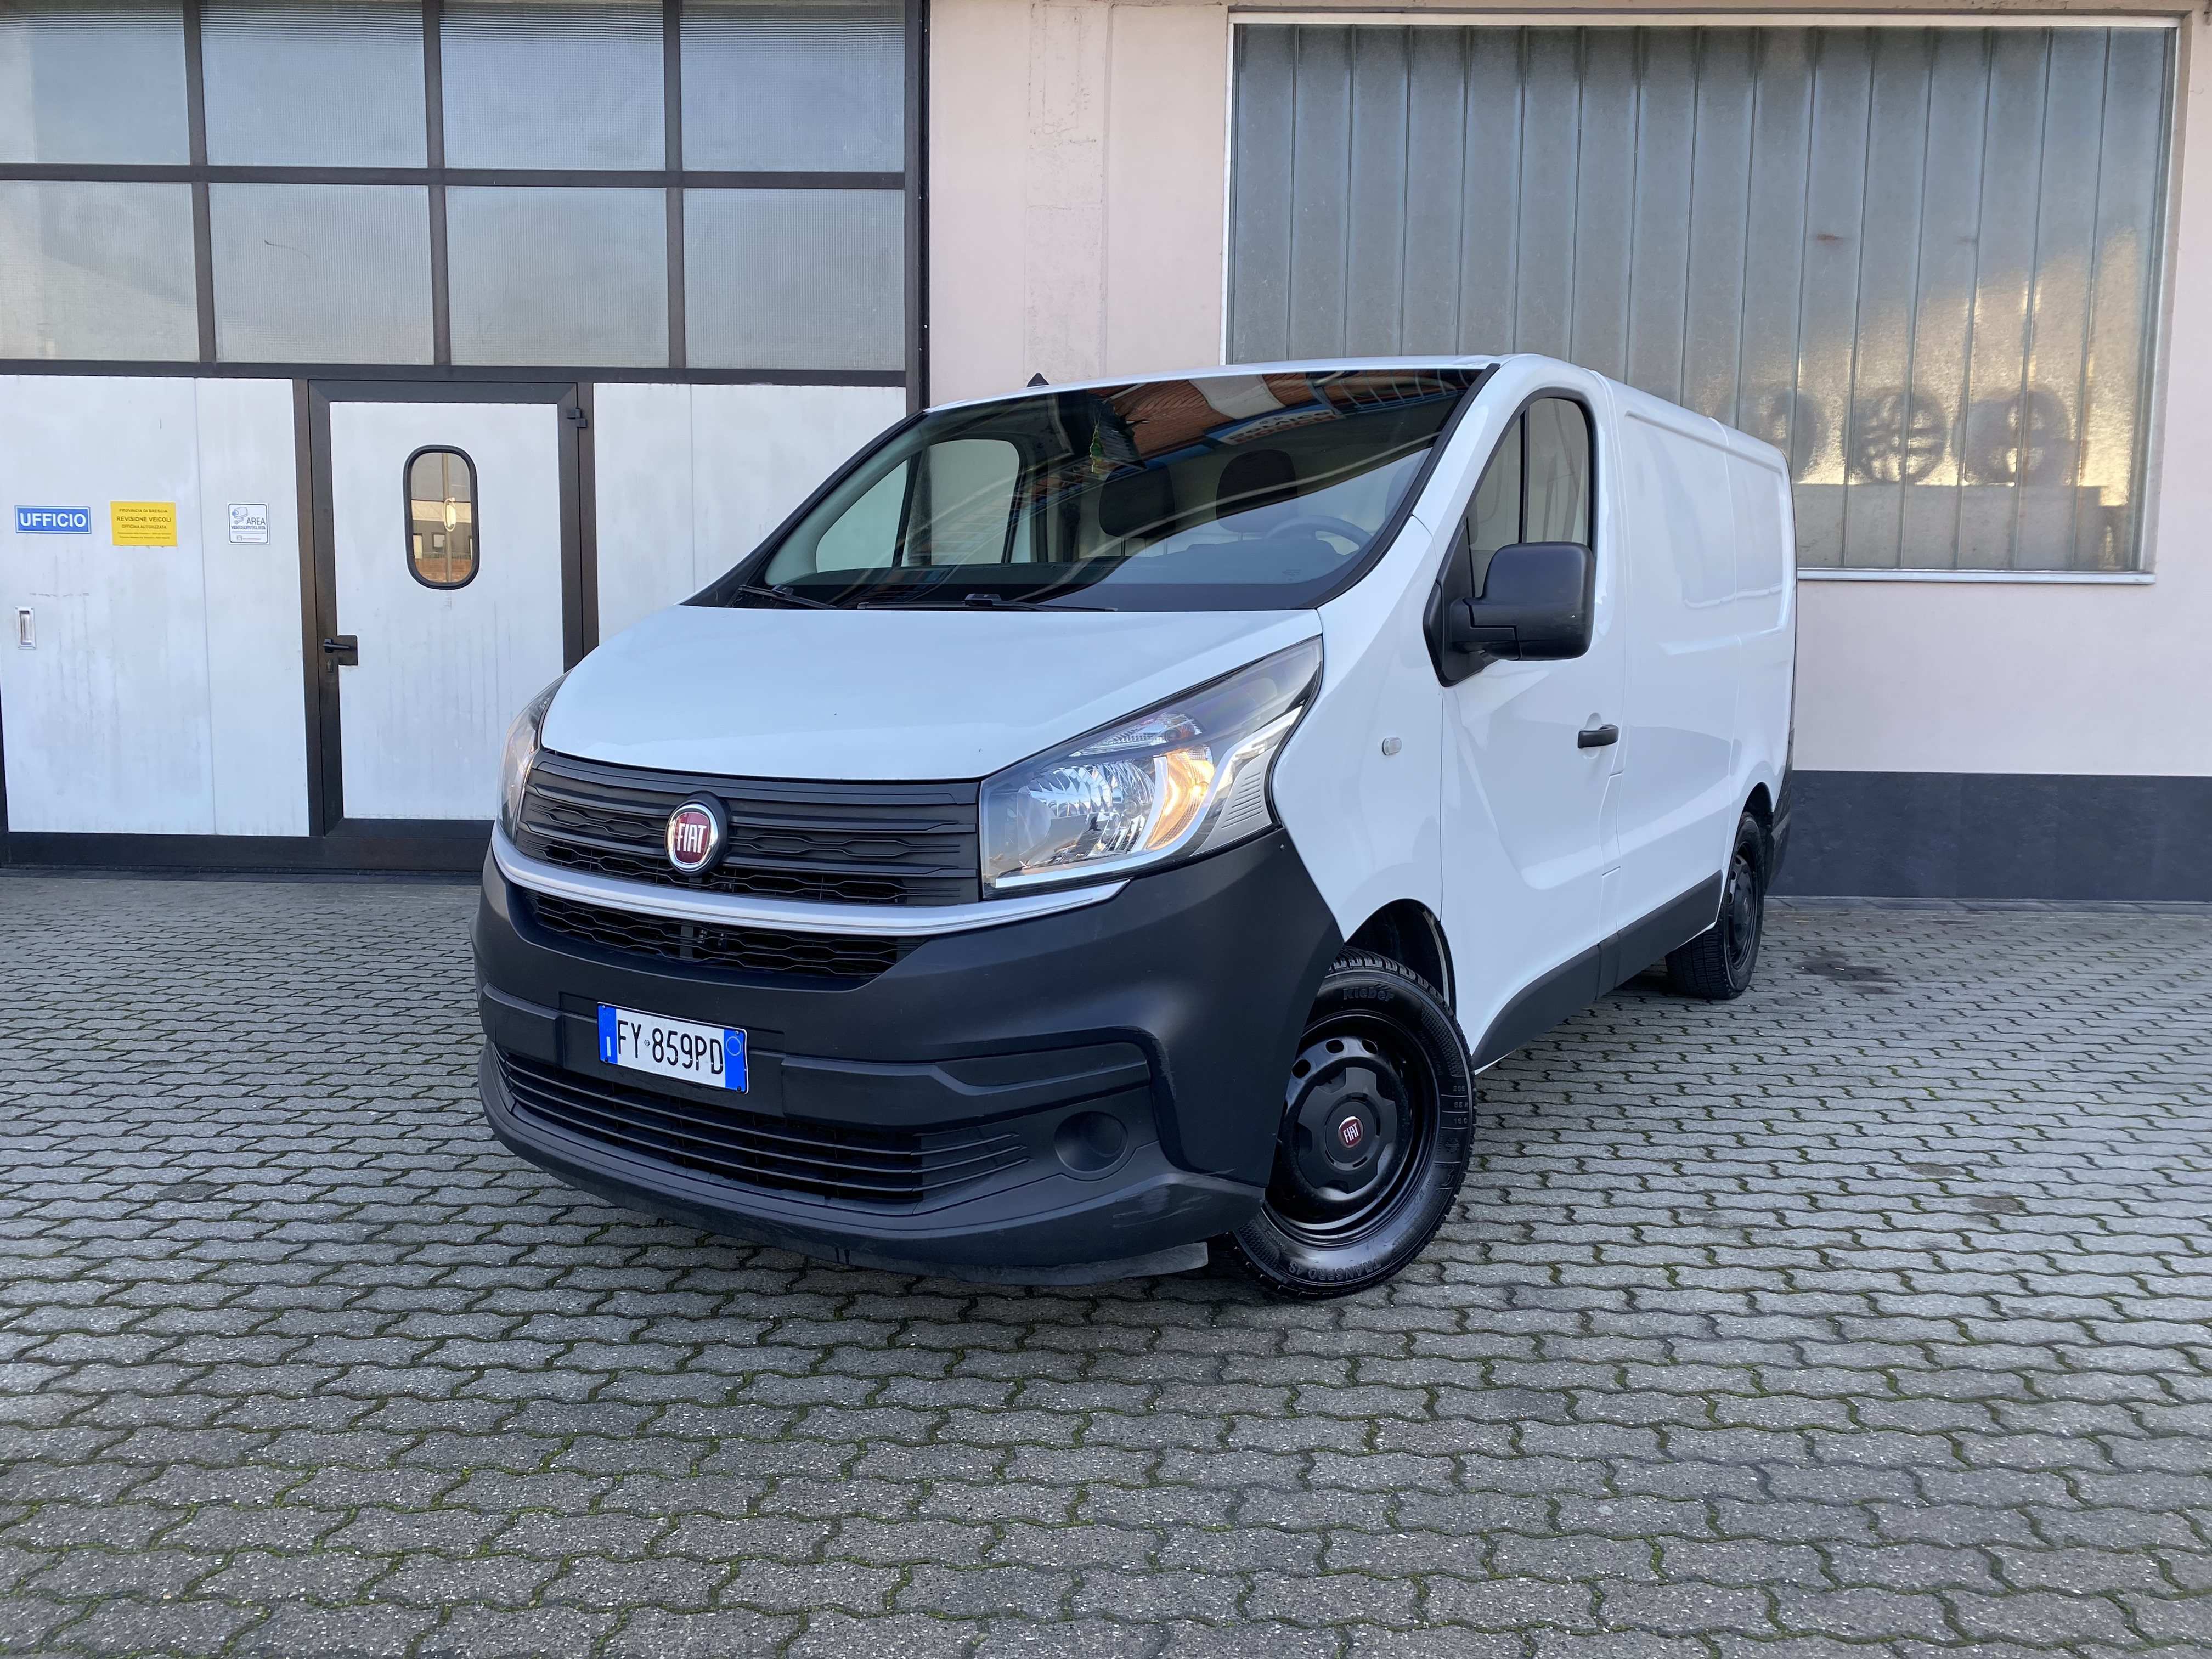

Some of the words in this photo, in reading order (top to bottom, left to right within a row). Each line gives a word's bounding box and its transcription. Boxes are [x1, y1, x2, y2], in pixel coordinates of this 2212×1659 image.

[20, 512, 86, 527] UFFICIO
[676, 823, 707, 853] FIAT
[617, 1019, 641, 1058] FY
[652, 1027, 724, 1075] 859PD
[1343, 1122, 1359, 1143] FIAT
[1308, 1258, 1381, 1281] TRANSPRO
